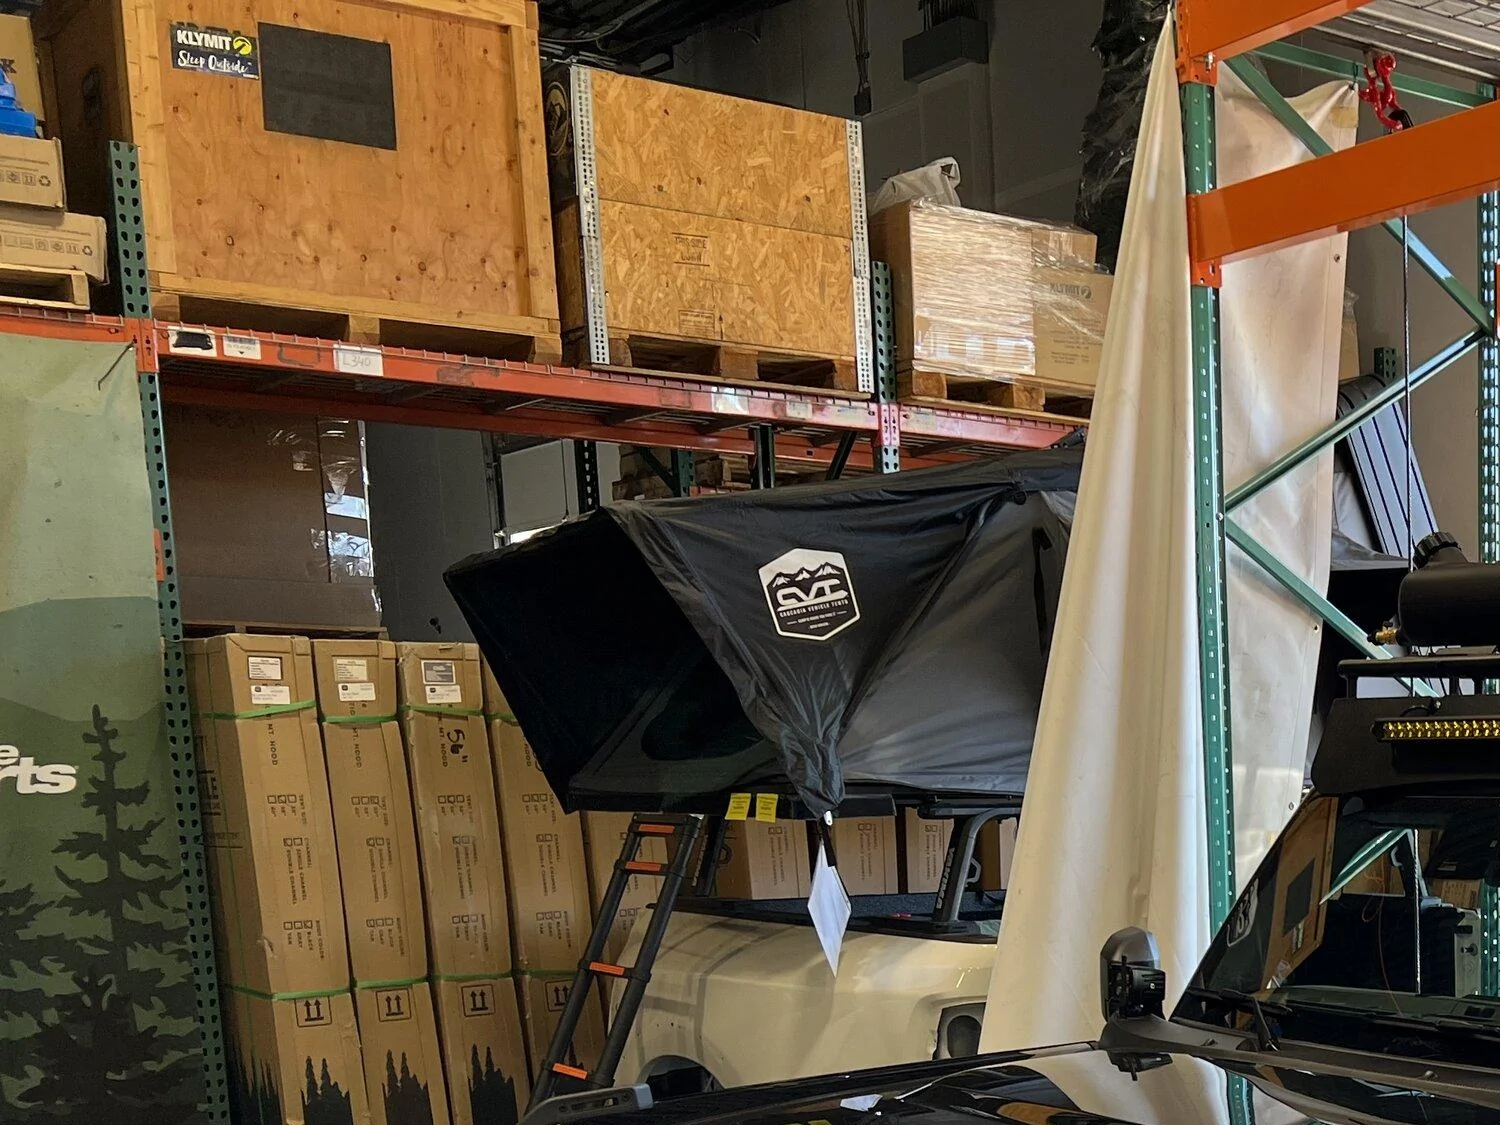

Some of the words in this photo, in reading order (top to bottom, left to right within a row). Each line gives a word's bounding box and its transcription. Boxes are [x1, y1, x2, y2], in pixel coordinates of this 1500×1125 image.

[176, 29, 232, 51] KLYMIT
[178, 50, 207, 69] Sleep
[440, 743, 449, 768] HOOD
